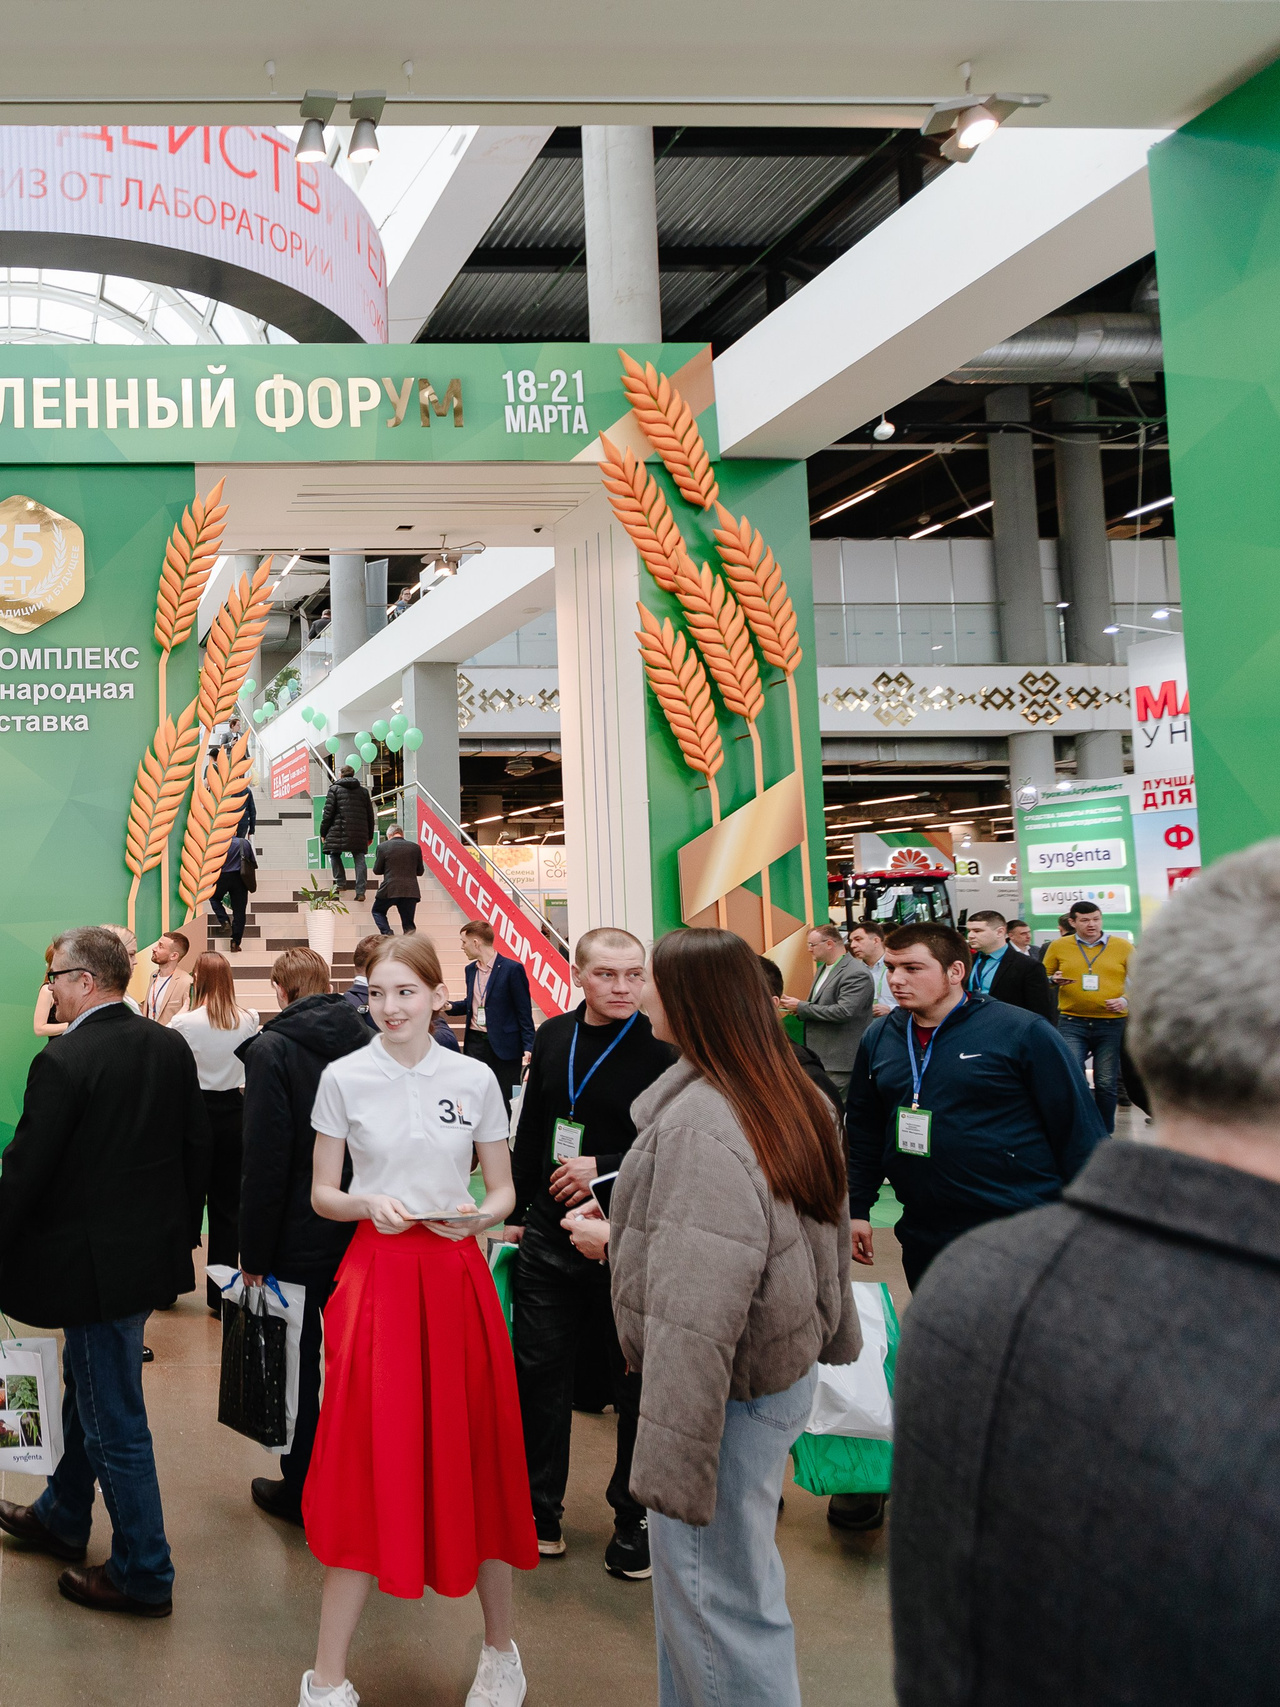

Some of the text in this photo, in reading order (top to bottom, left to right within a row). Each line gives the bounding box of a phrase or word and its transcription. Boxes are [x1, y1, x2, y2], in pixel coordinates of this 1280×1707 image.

[60, 171, 111, 204] ОТ
[121, 177, 335, 283] ЛАБОРАТОРИИ
[502, 370, 585, 403] 18-21
[255, 373, 464, 433] ФОРУМ
[505, 405, 589, 434] МАРТА
[45, 594, 54, 603] И
[52, 545, 80, 596] БУДУЩЕЕ
[1143, 788, 1193, 810] ДЛЯ
[1039, 847, 1111, 868] syngenta
[1042, 889, 1084, 904] avgust
[13, 1454, 43, 1463] syngenta
